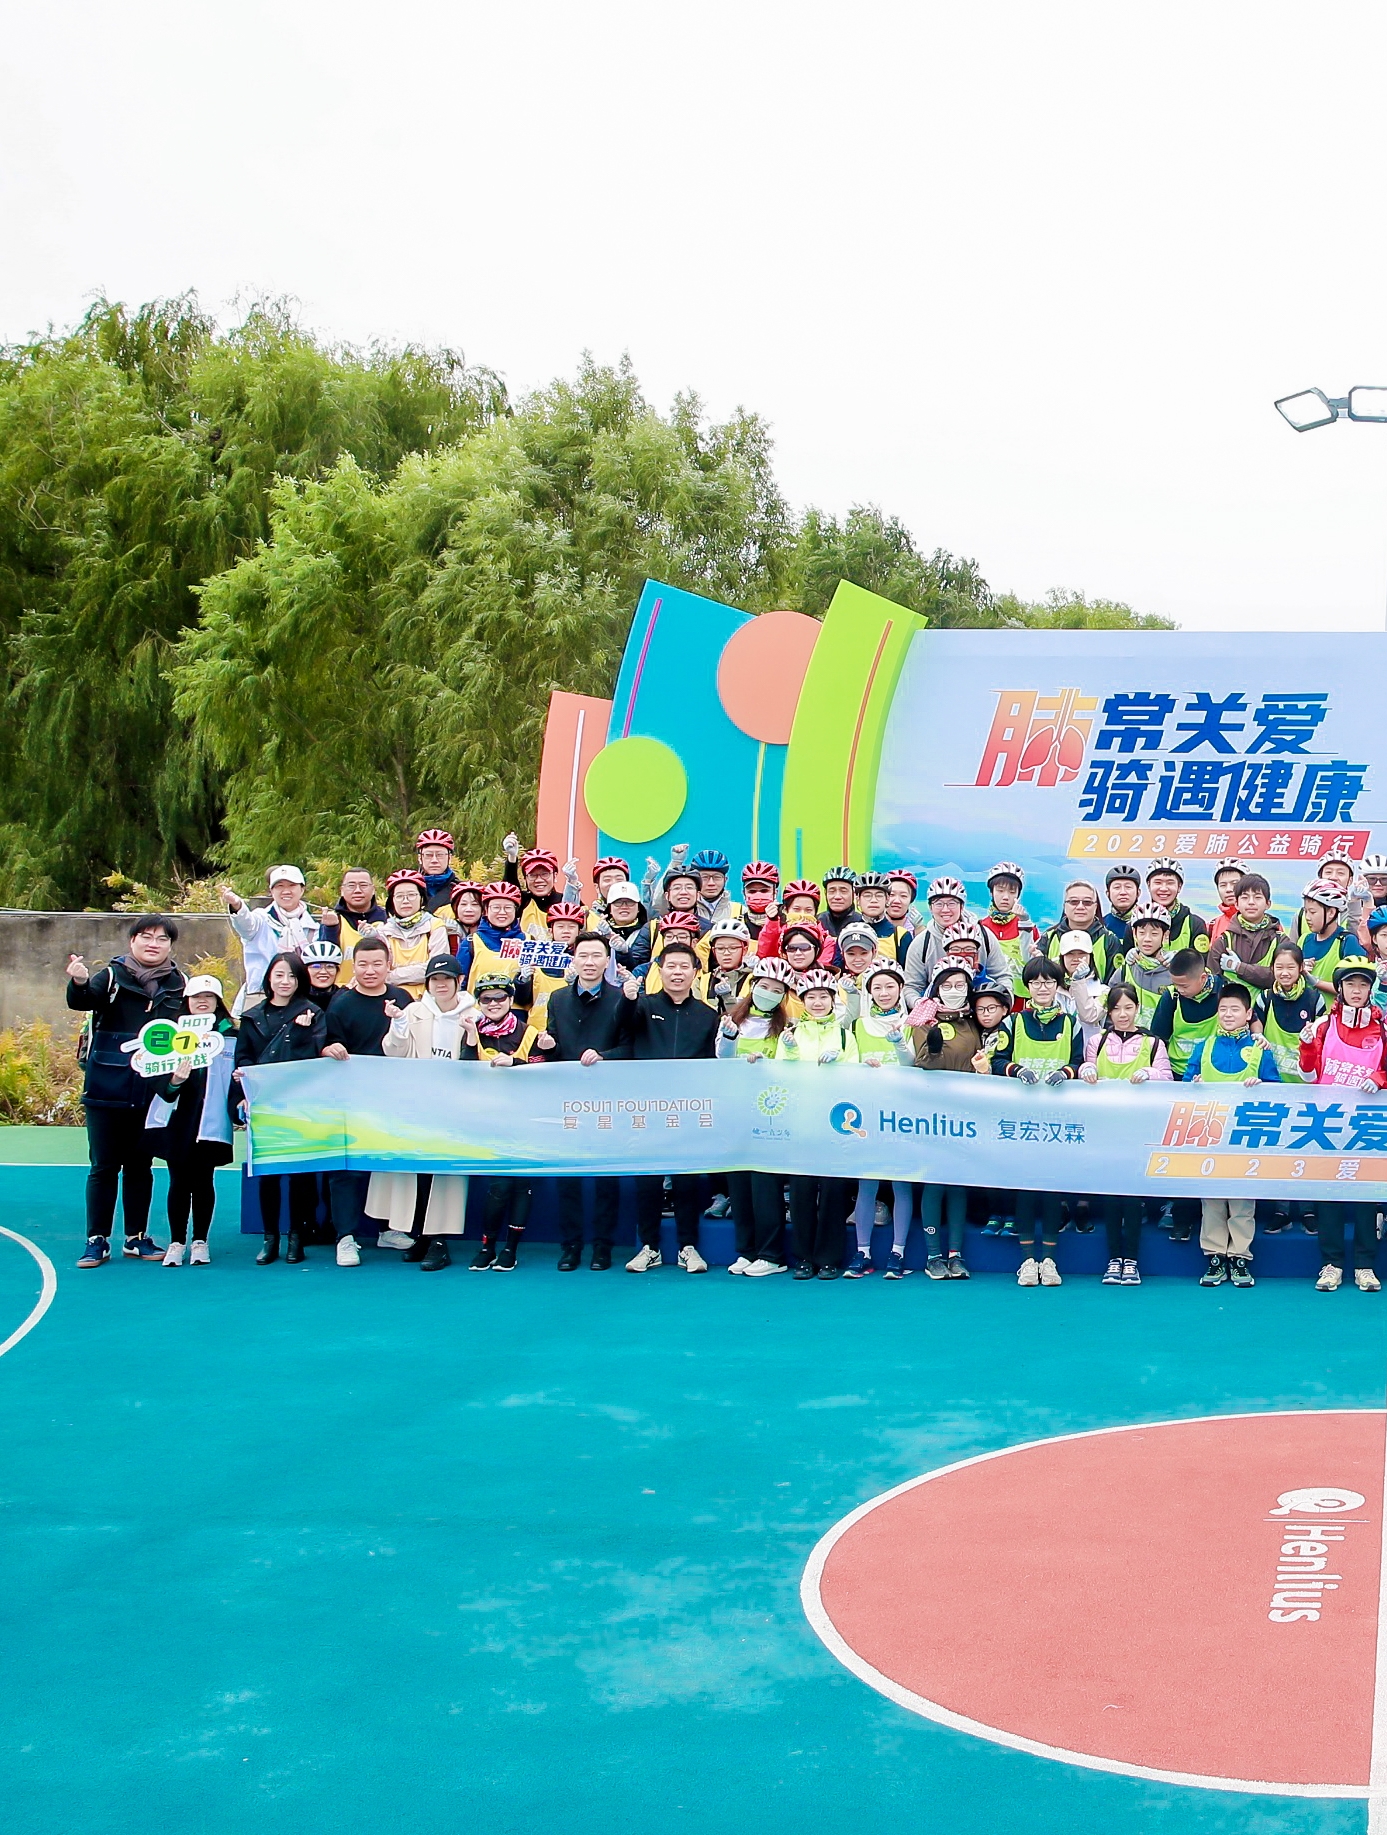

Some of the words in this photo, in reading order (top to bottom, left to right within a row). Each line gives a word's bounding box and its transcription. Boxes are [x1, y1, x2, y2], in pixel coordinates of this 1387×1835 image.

[1077, 759, 1371, 824] 骑遇健康
[182, 1017, 211, 1029] HOT
[563, 1100, 613, 1113] FOSUN
[617, 1098, 714, 1113] FOUNDATION
[563, 1114, 714, 1130] 复星基金会
[879, 1110, 977, 1139] Henlius
[996, 1118, 1086, 1145] 复宏汉霖
[1267, 1524, 1346, 1623] Henlius
